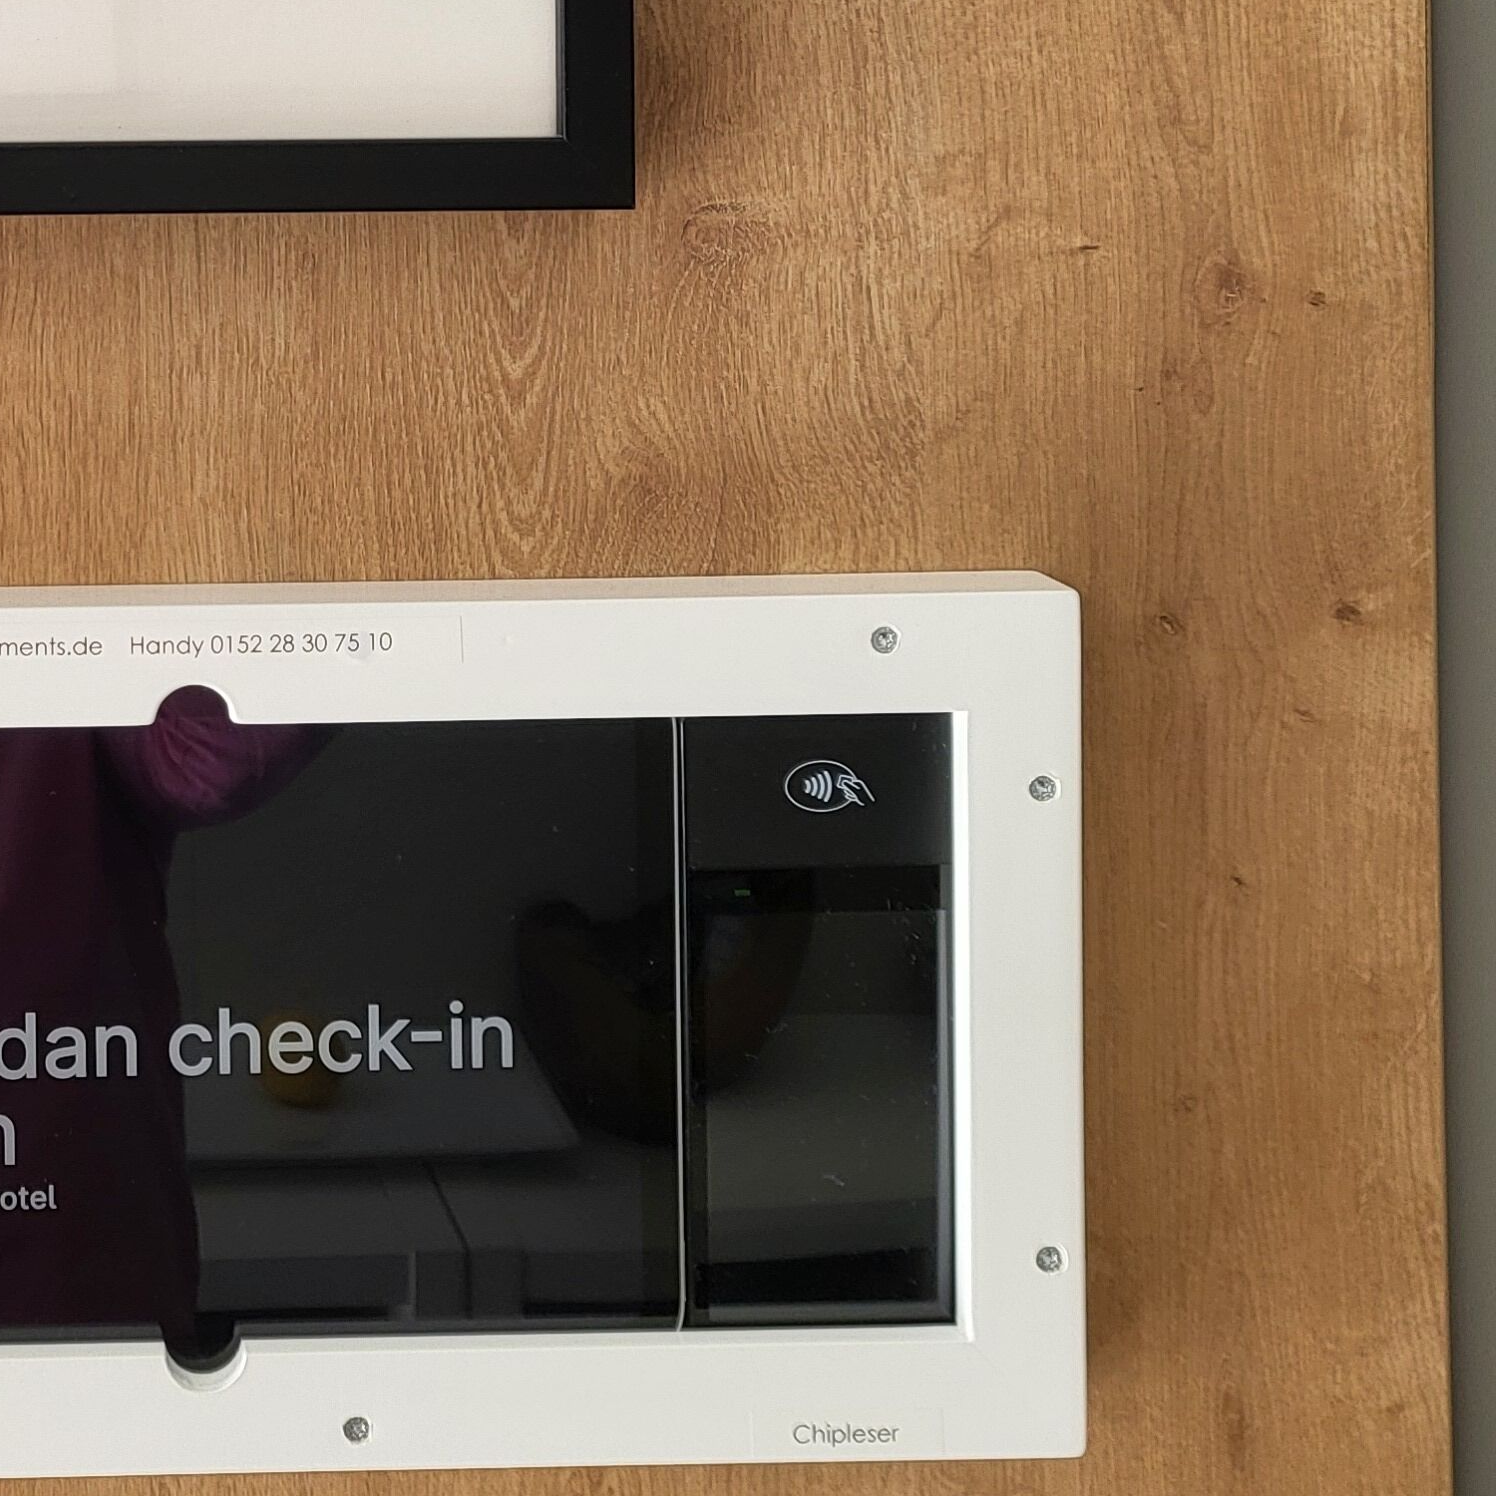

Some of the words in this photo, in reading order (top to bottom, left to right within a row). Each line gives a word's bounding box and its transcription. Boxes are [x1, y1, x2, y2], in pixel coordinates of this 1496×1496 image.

[130, 635, 204, 659] Handy
[210, 634, 262, 655] 0152
[269, 633, 295, 653] 28
[302, 633, 328, 653] 30
[334, 632, 360, 653] 75
[369, 631, 393, 652] 10
[168, 1000, 514, 1077] check-in
[792, 1421, 900, 1447] Chipleser
